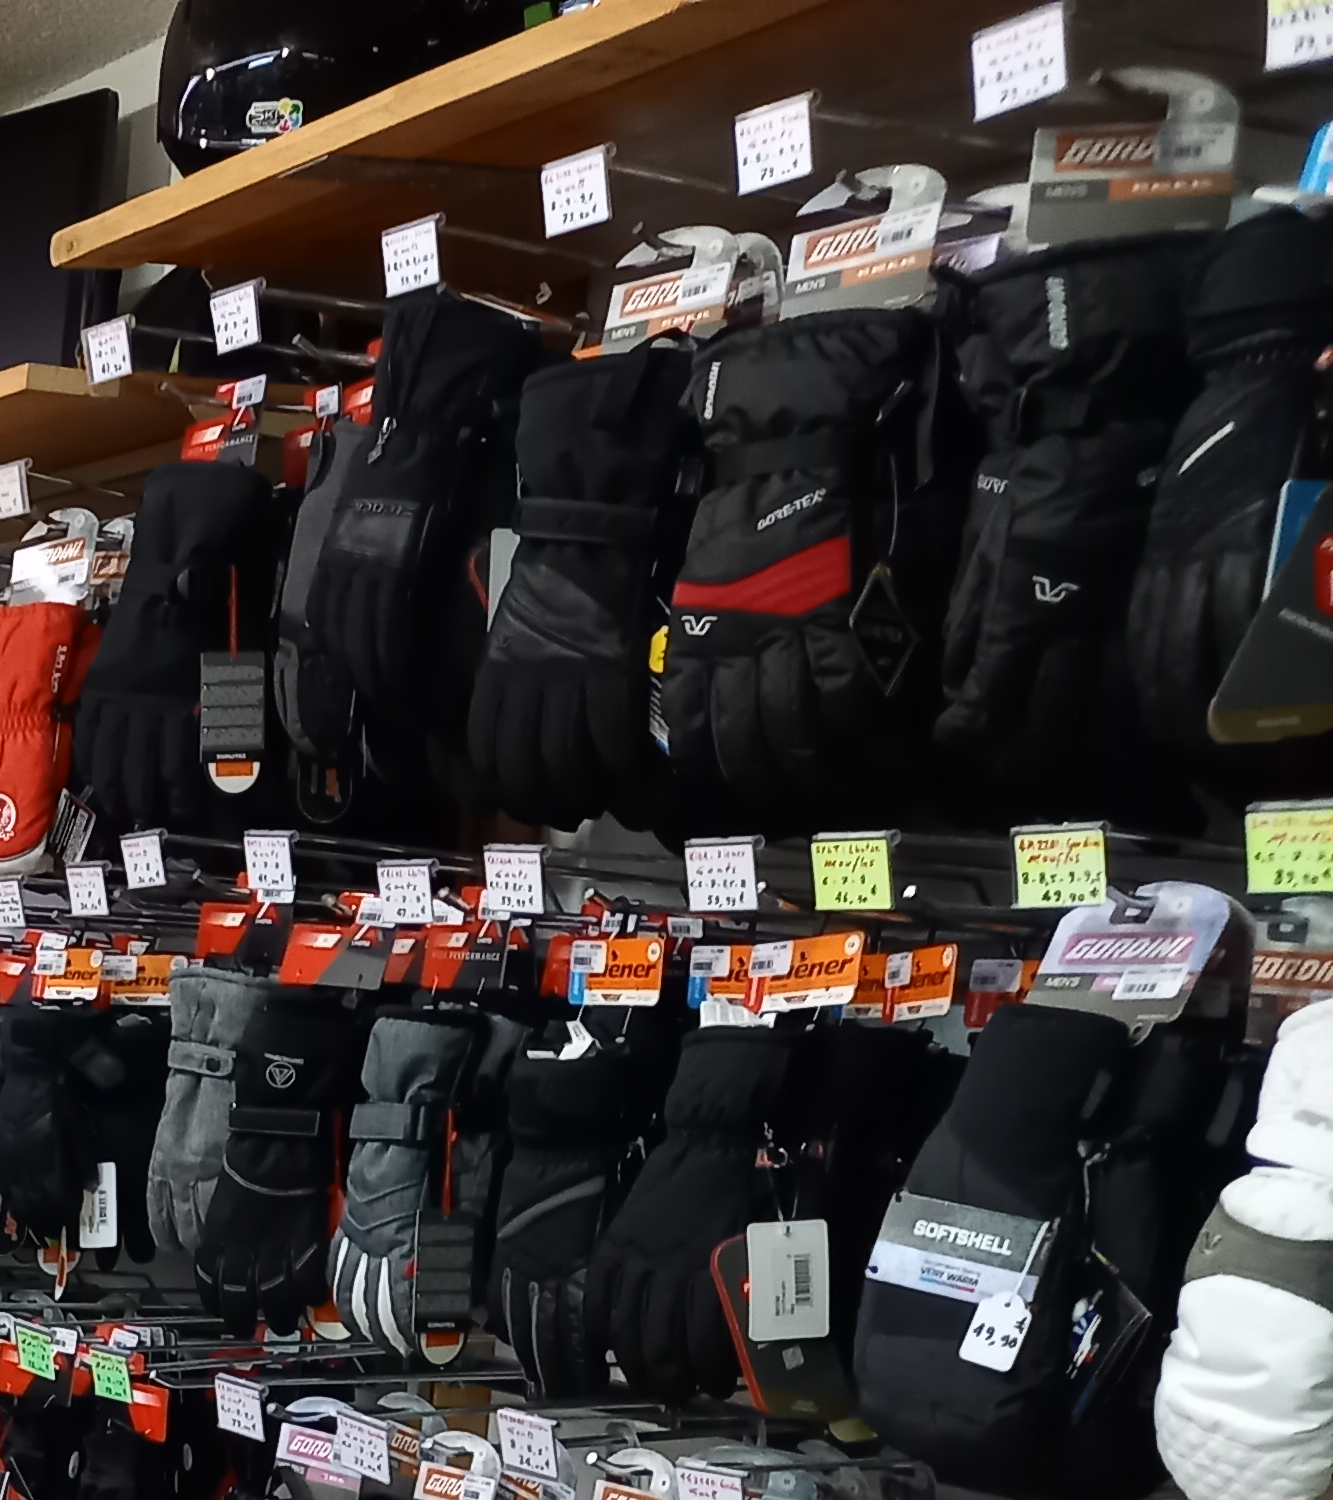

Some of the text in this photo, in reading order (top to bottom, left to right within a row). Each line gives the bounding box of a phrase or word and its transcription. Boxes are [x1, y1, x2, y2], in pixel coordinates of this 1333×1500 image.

[1061, 135, 1156, 165] GORD
[808, 224, 881, 264] GORD
[624, 275, 684, 313] GORD
[1065, 936, 1194, 960] GORDINI
[913, 1219, 1013, 1256] SOFTSHELL
[288, 1434, 333, 1459] GORD
[425, 1473, 465, 1496] GORD
